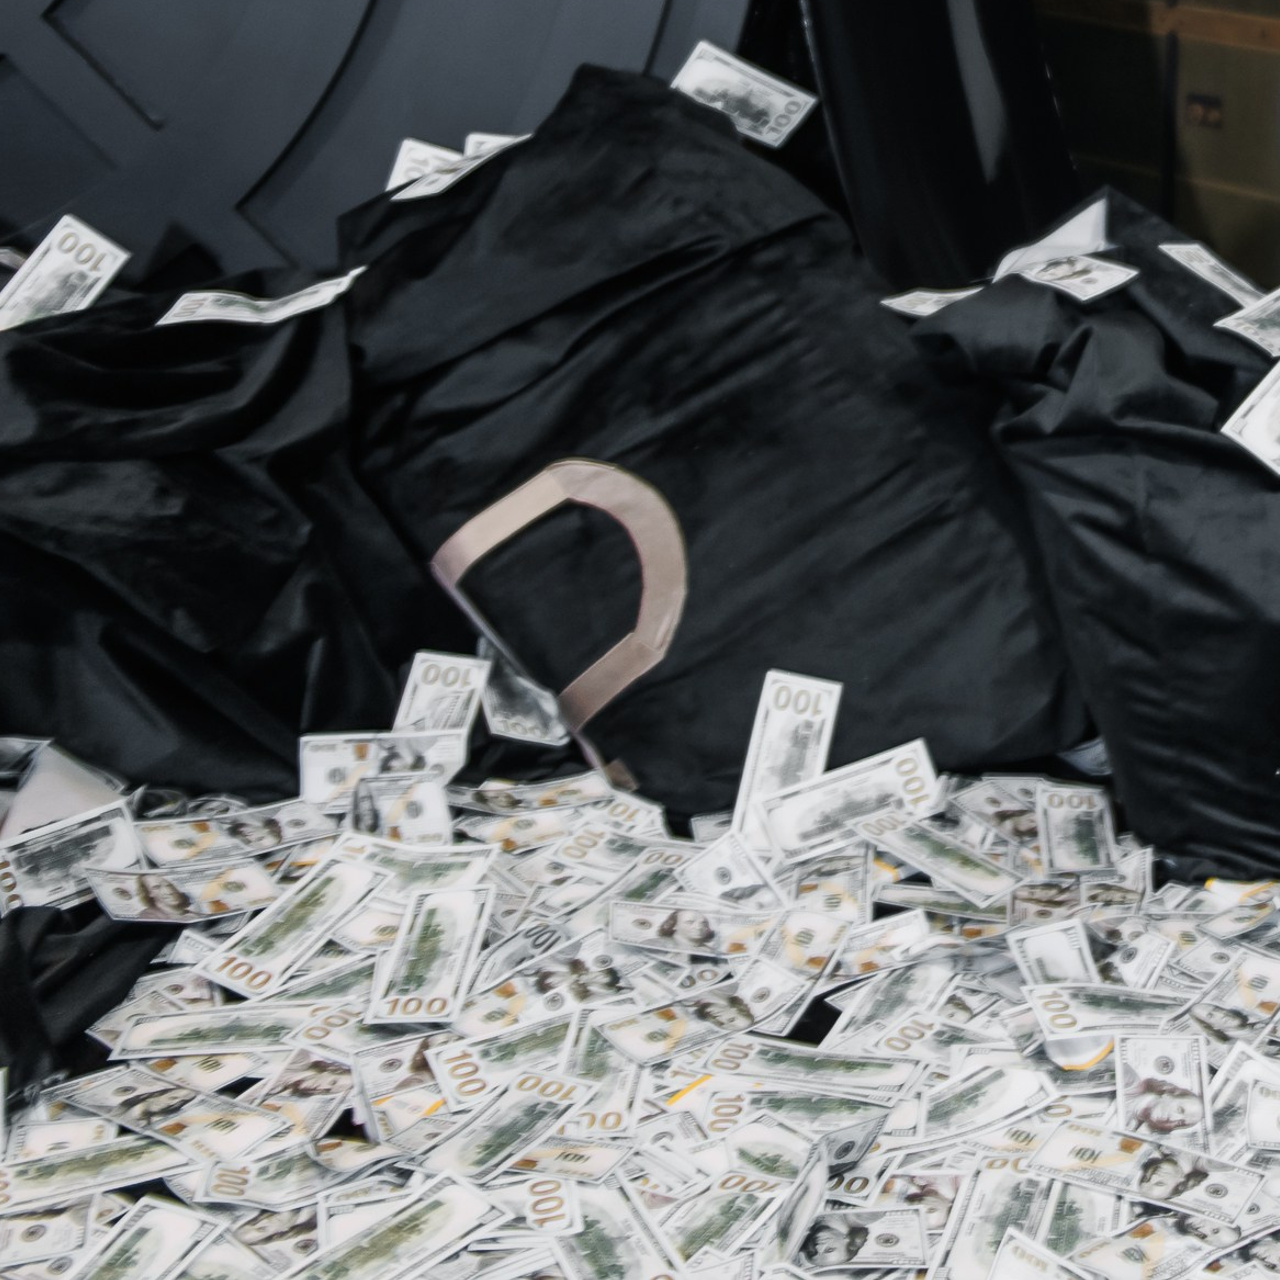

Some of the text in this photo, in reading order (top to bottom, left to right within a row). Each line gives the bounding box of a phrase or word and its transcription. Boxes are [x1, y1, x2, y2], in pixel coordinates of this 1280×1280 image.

[57, 232, 108, 272] 100
[421, 663, 473, 688] 100
[773, 685, 822, 716] 100
[896, 757, 930, 807] 100
[1049, 794, 1096, 810] 100
[563, 829, 606, 859] 100
[217, 956, 272, 990] 100
[386, 997, 448, 1016] 100
[1036, 990, 1078, 1029] 100
[303, 1009, 363, 1041] 100
[884, 1019, 936, 1052] 100
[711, 1042, 755, 1071] 100
[444, 1049, 487, 1097] 100
[517, 1075, 578, 1102] 100
[708, 1094, 746, 1133] 100
[211, 1166, 251, 1197] 100
[719, 1174, 776, 1193] 100
[529, 1179, 566, 1228] 100
